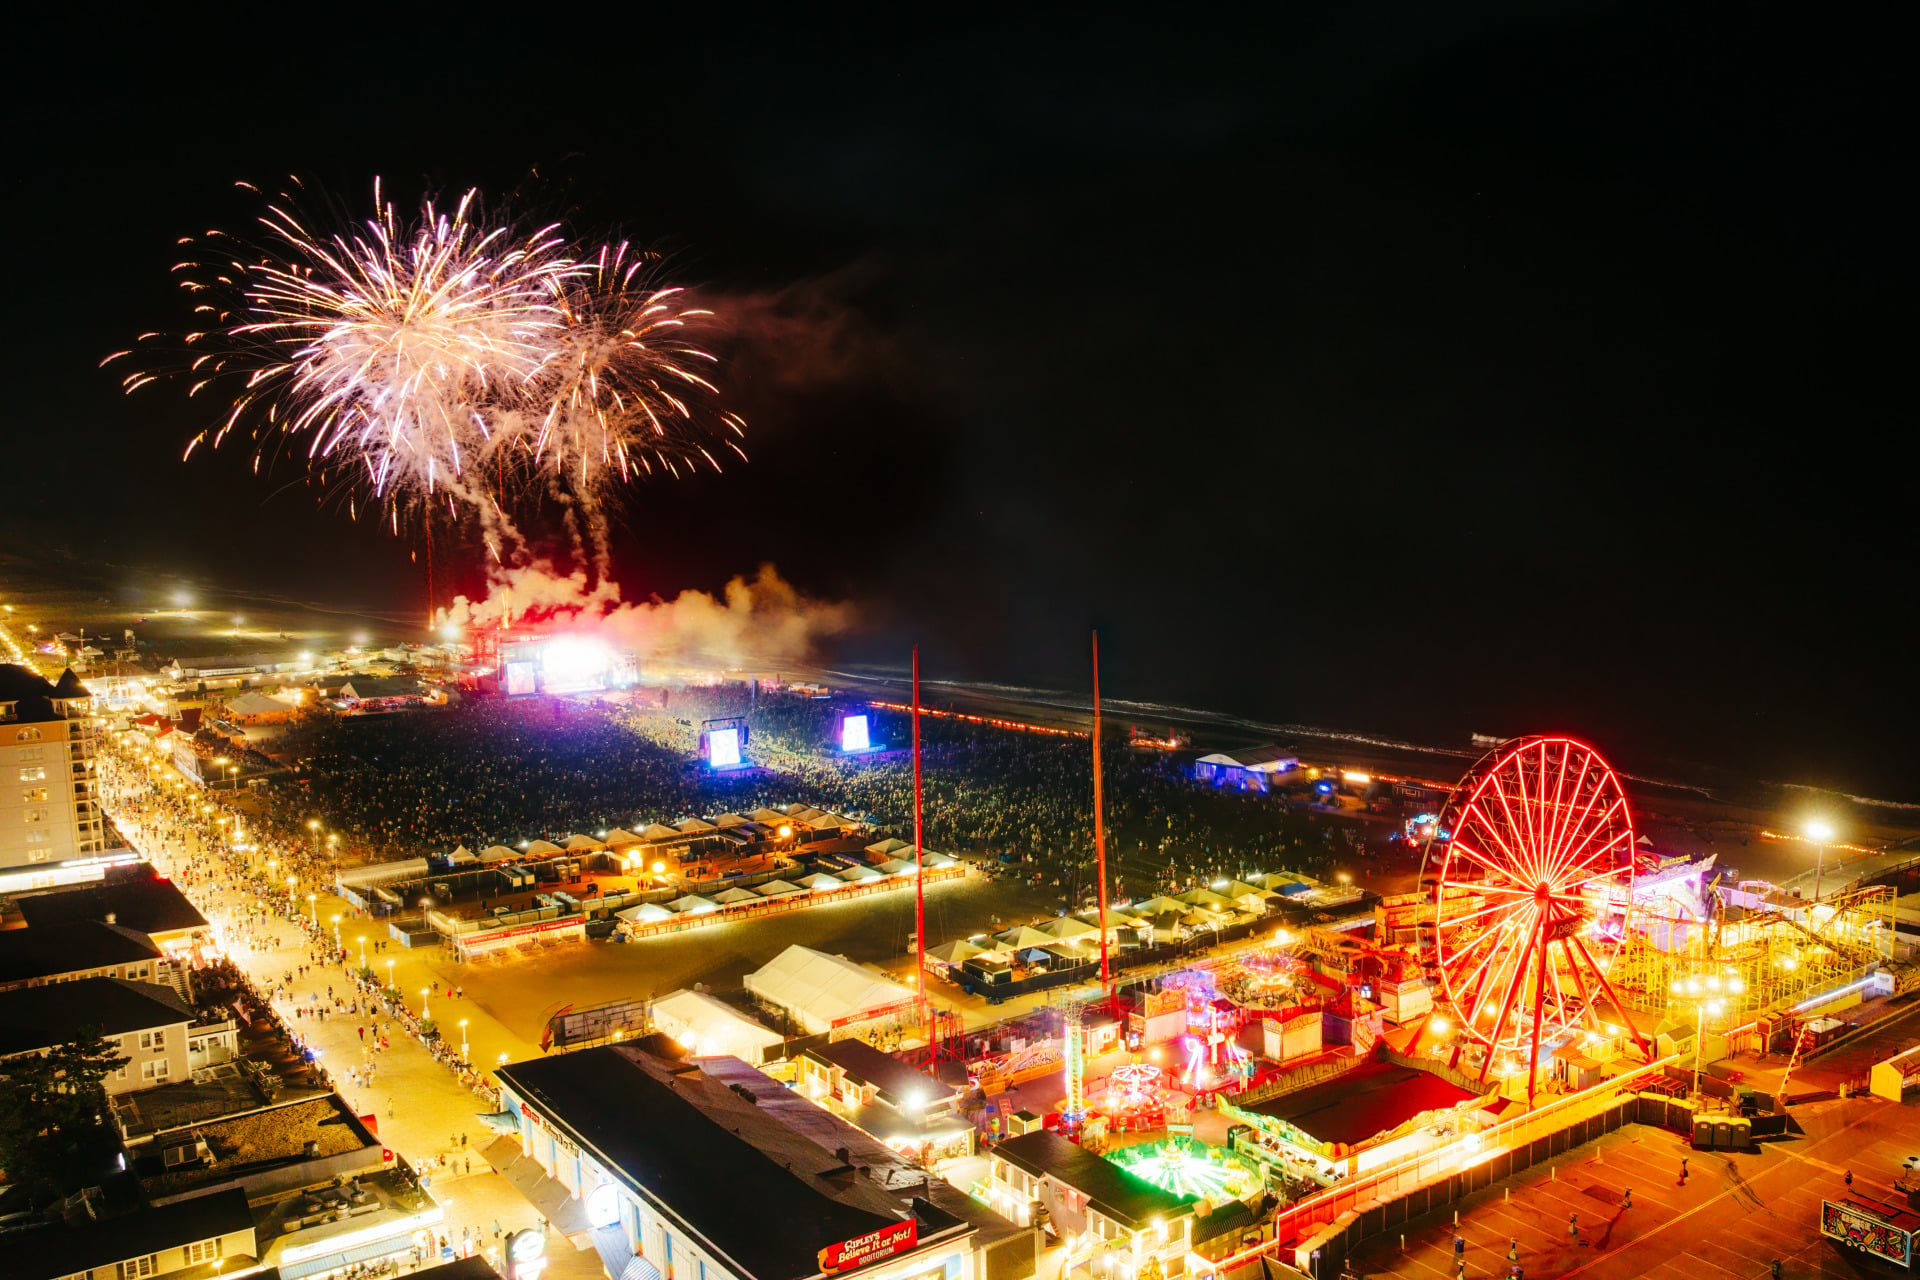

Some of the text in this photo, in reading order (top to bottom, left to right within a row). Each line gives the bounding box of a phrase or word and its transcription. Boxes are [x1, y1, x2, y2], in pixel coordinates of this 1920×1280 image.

[838, 1227, 911, 1263] Believe It or Not!
[844, 1232, 880, 1251] RIPLEY'S
[858, 1246, 894, 1264] ODDITORIUM
